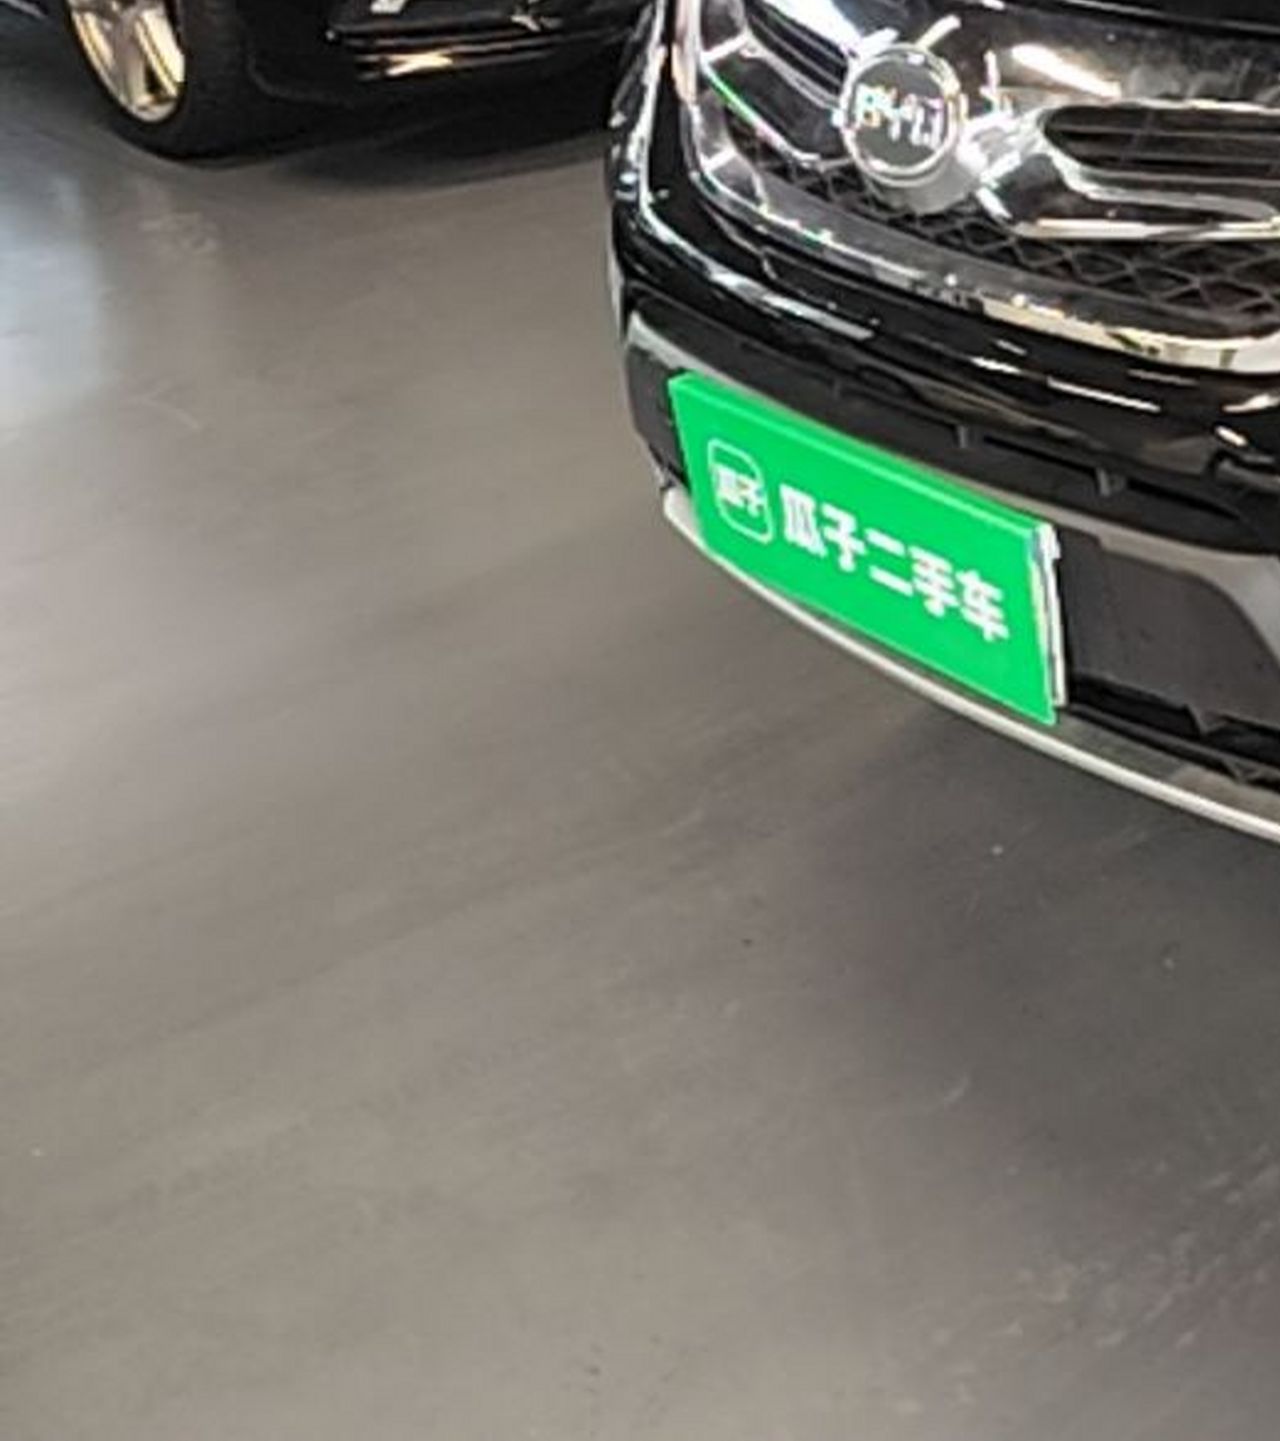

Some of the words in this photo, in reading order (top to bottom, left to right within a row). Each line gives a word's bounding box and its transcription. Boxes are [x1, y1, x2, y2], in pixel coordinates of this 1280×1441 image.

[779, 483, 1010, 642] 瓜子二手车
